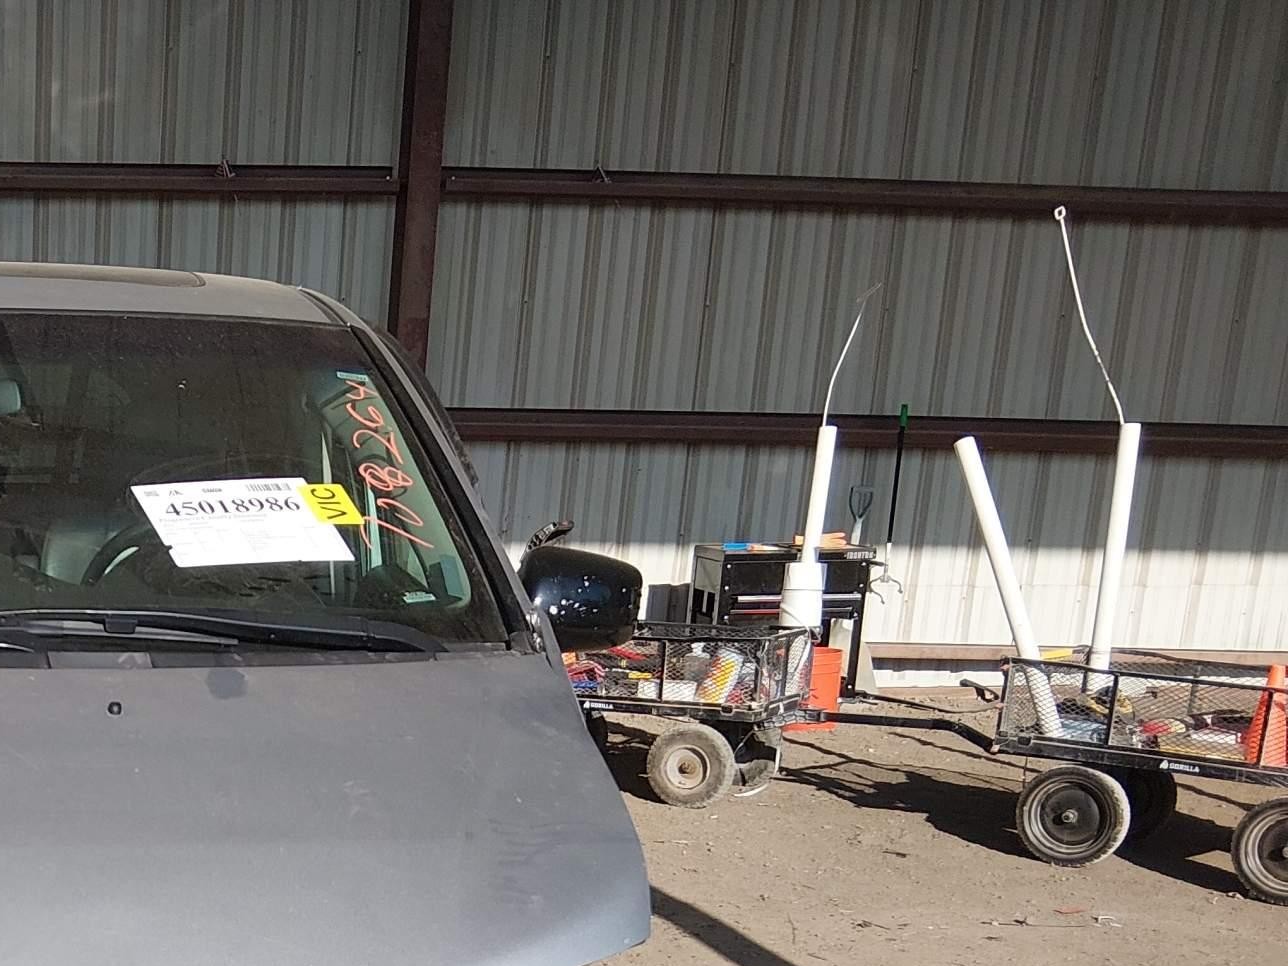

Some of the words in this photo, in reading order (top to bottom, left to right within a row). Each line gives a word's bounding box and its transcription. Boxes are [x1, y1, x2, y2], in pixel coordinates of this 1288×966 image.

[165, 495, 301, 517] 45018986
[311, 486, 348, 520] VIC
[1169, 762, 1200, 773] GORILLA
